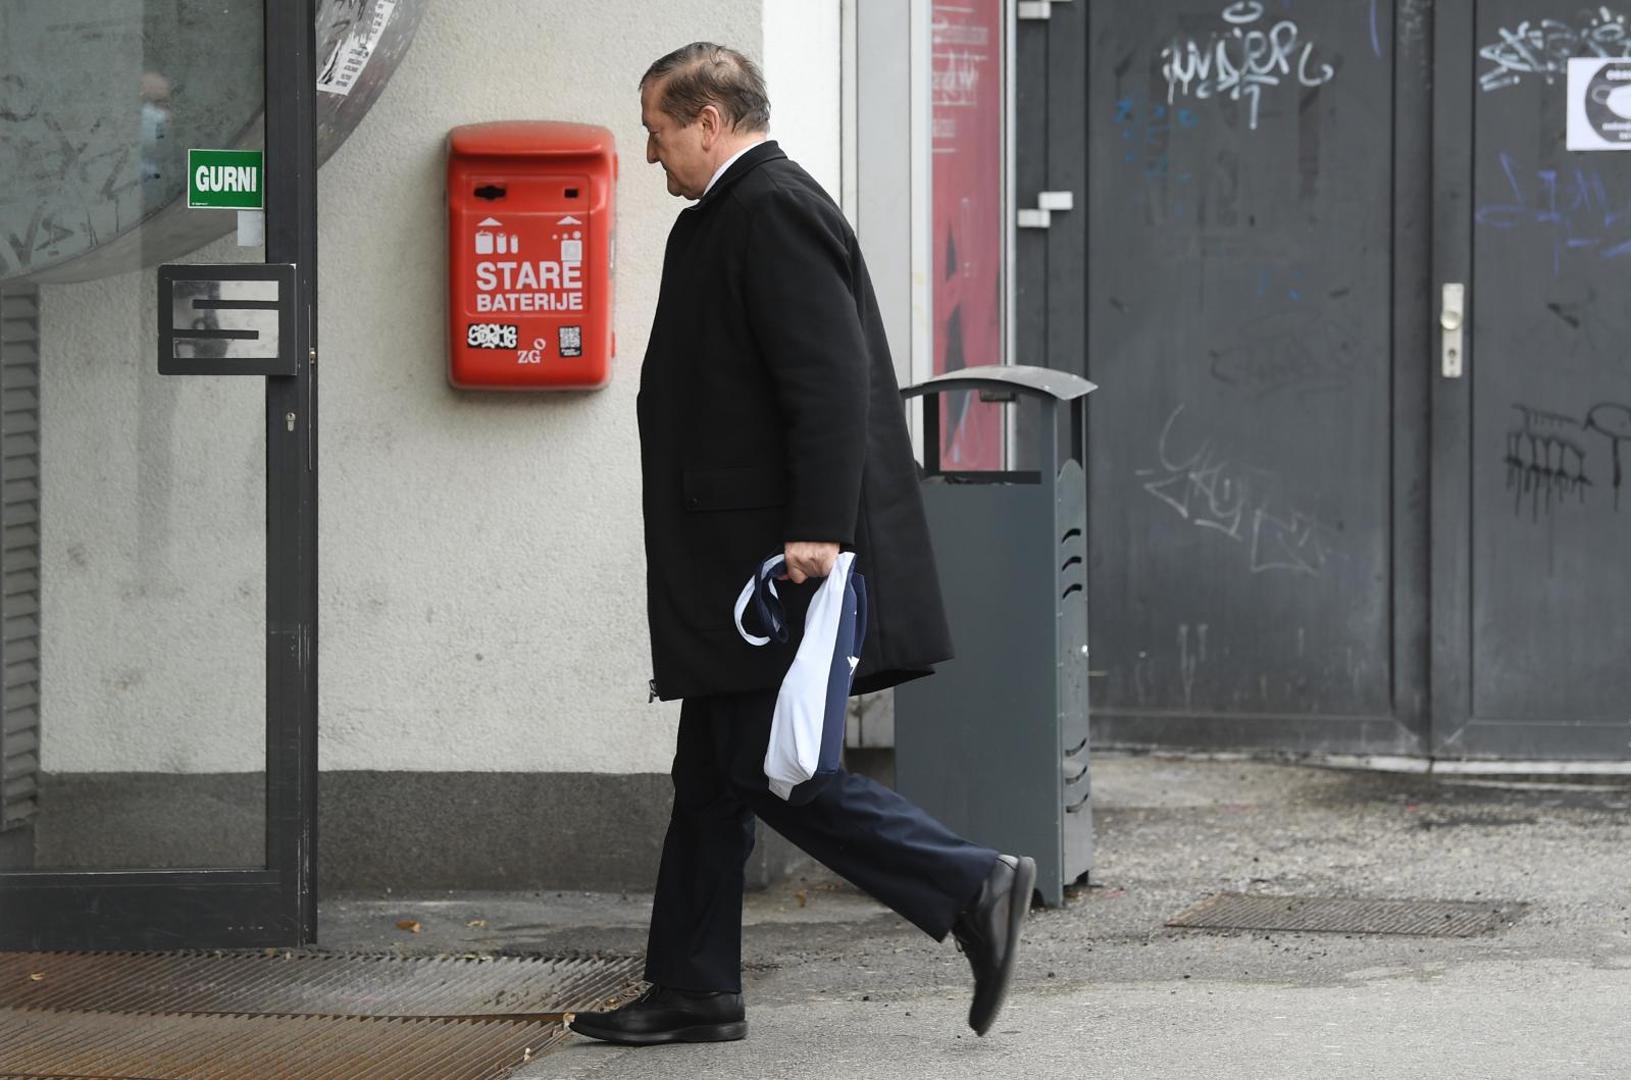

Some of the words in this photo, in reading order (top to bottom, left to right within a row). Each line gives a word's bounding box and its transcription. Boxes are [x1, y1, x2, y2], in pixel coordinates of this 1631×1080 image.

[195, 164, 257, 193] GURNI
[476, 261, 583, 291] STARE
[476, 292, 583, 312] BATERIJE
